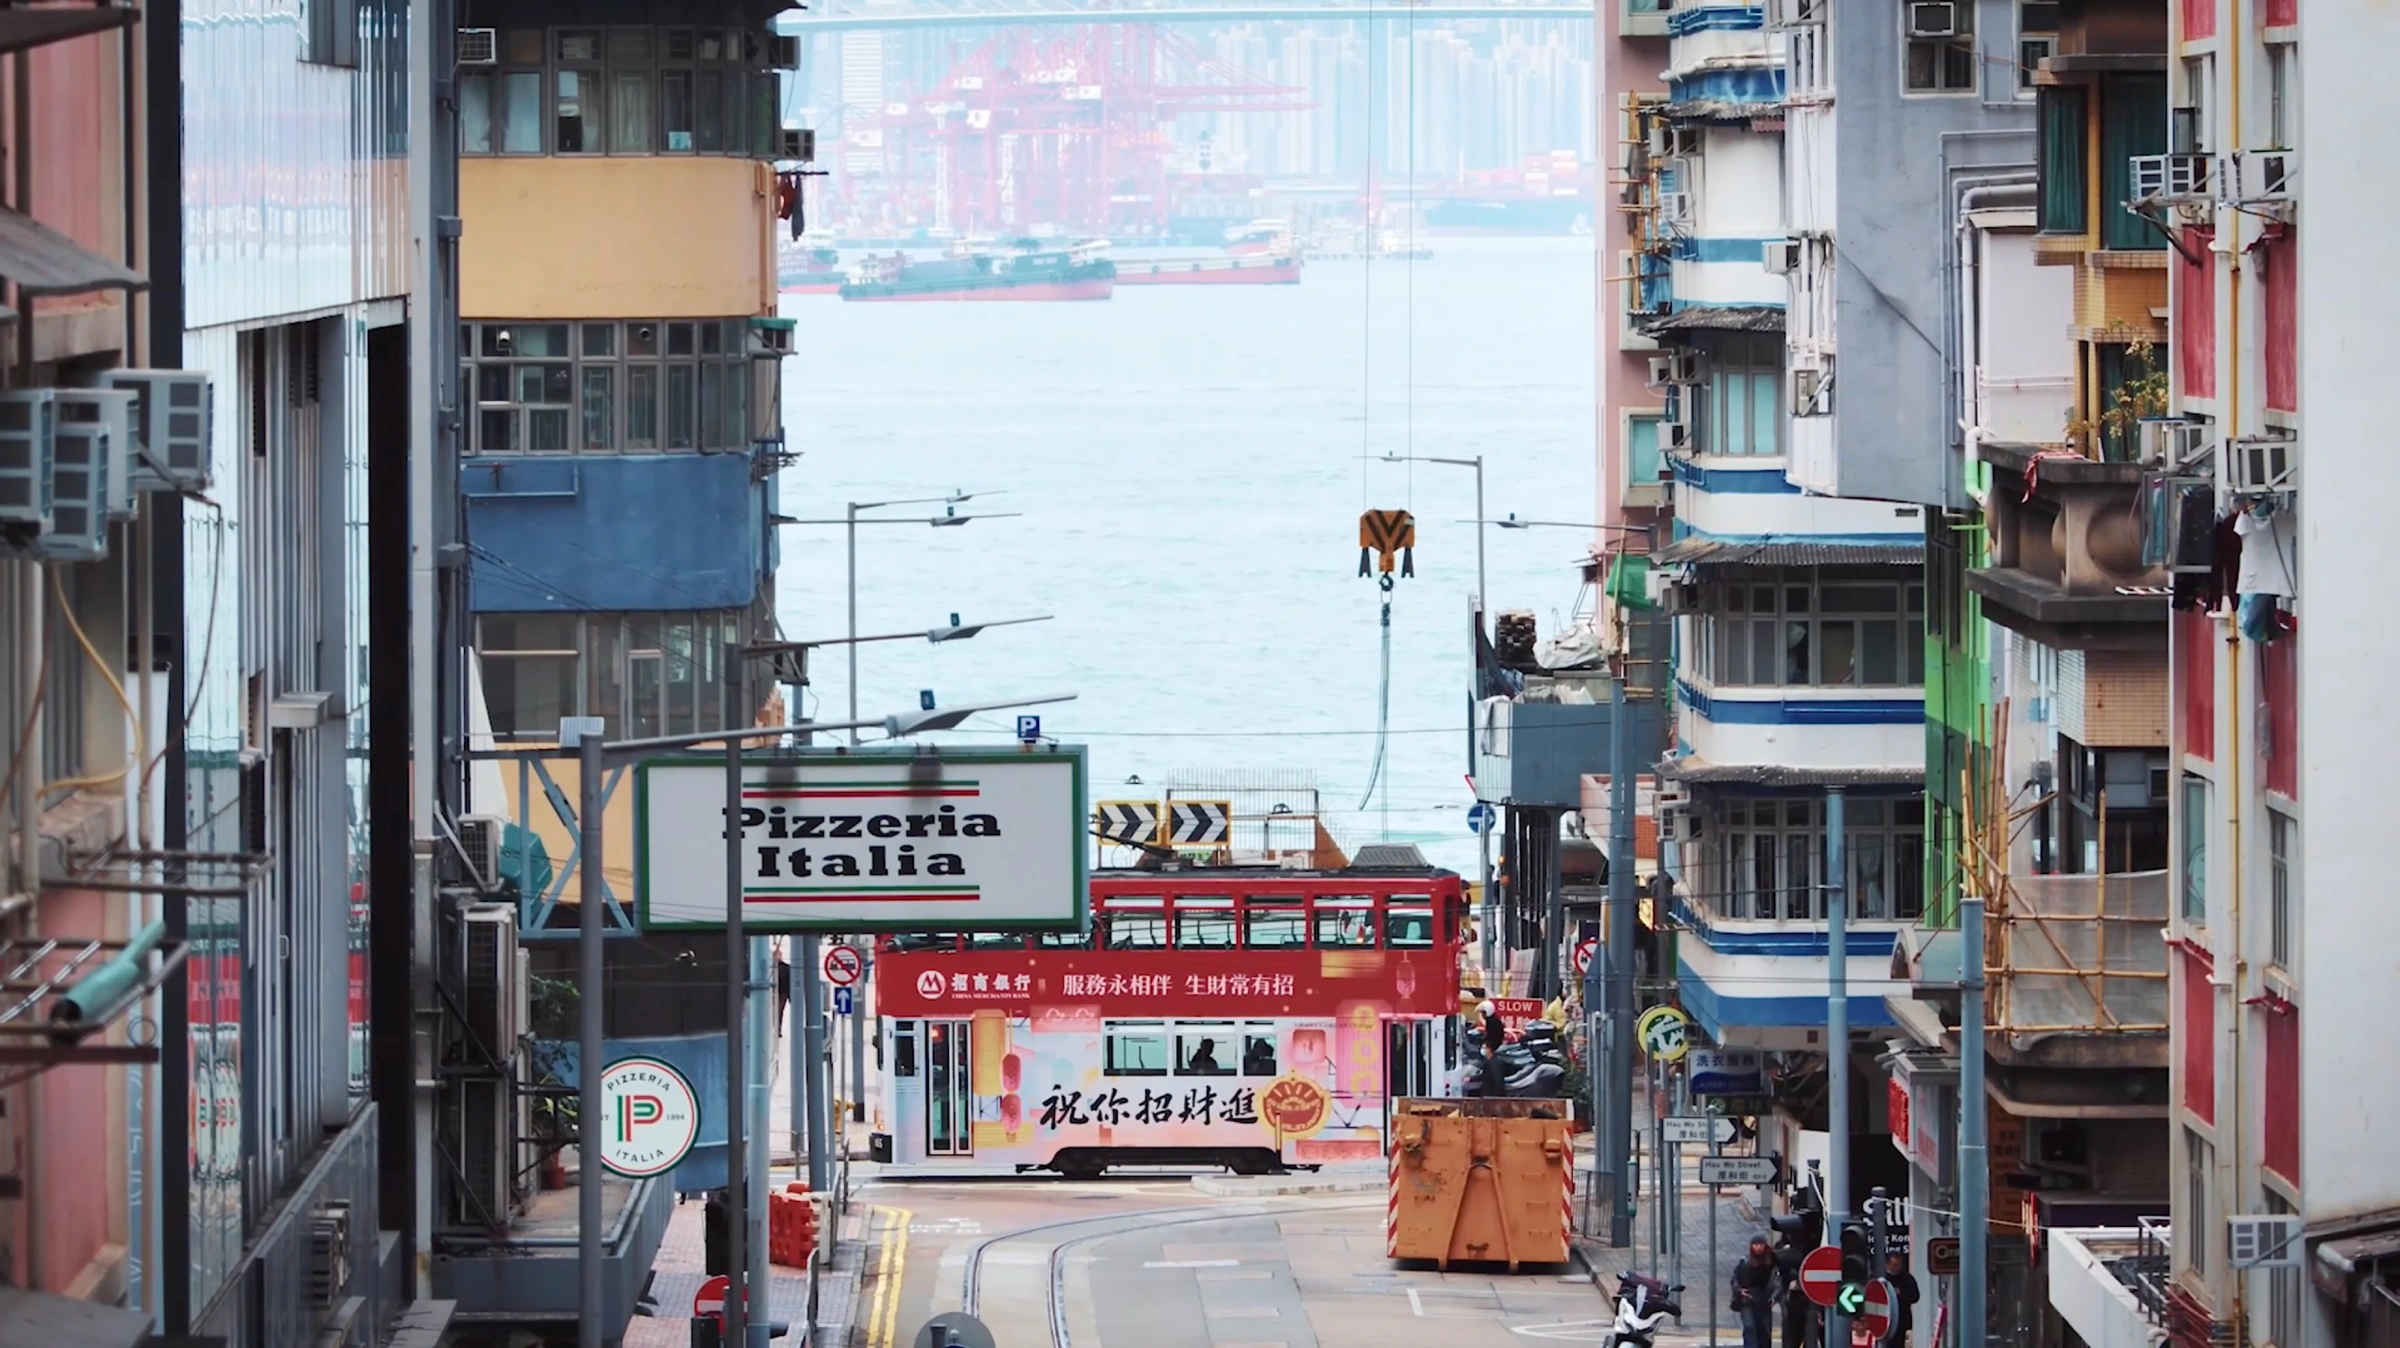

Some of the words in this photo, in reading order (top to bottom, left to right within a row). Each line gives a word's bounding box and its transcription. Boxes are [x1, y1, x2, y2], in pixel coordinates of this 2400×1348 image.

[722, 805, 1001, 839] Pizzeria
[758, 845, 965, 877] Italia
[951, 972, 1031, 992] 招商銀行
[1062, 973, 1173, 996] 服務永相伴
[1185, 973, 1294, 996] 生財常有招
[1497, 1001, 1533, 1012] SLOW
[607, 1072, 671, 1092] PIZZERIA
[1039, 1084, 1259, 1130] 祝你招財進
[615, 1148, 665, 1163] ITALIA
[1891, 1233, 1910, 1243] Kon
